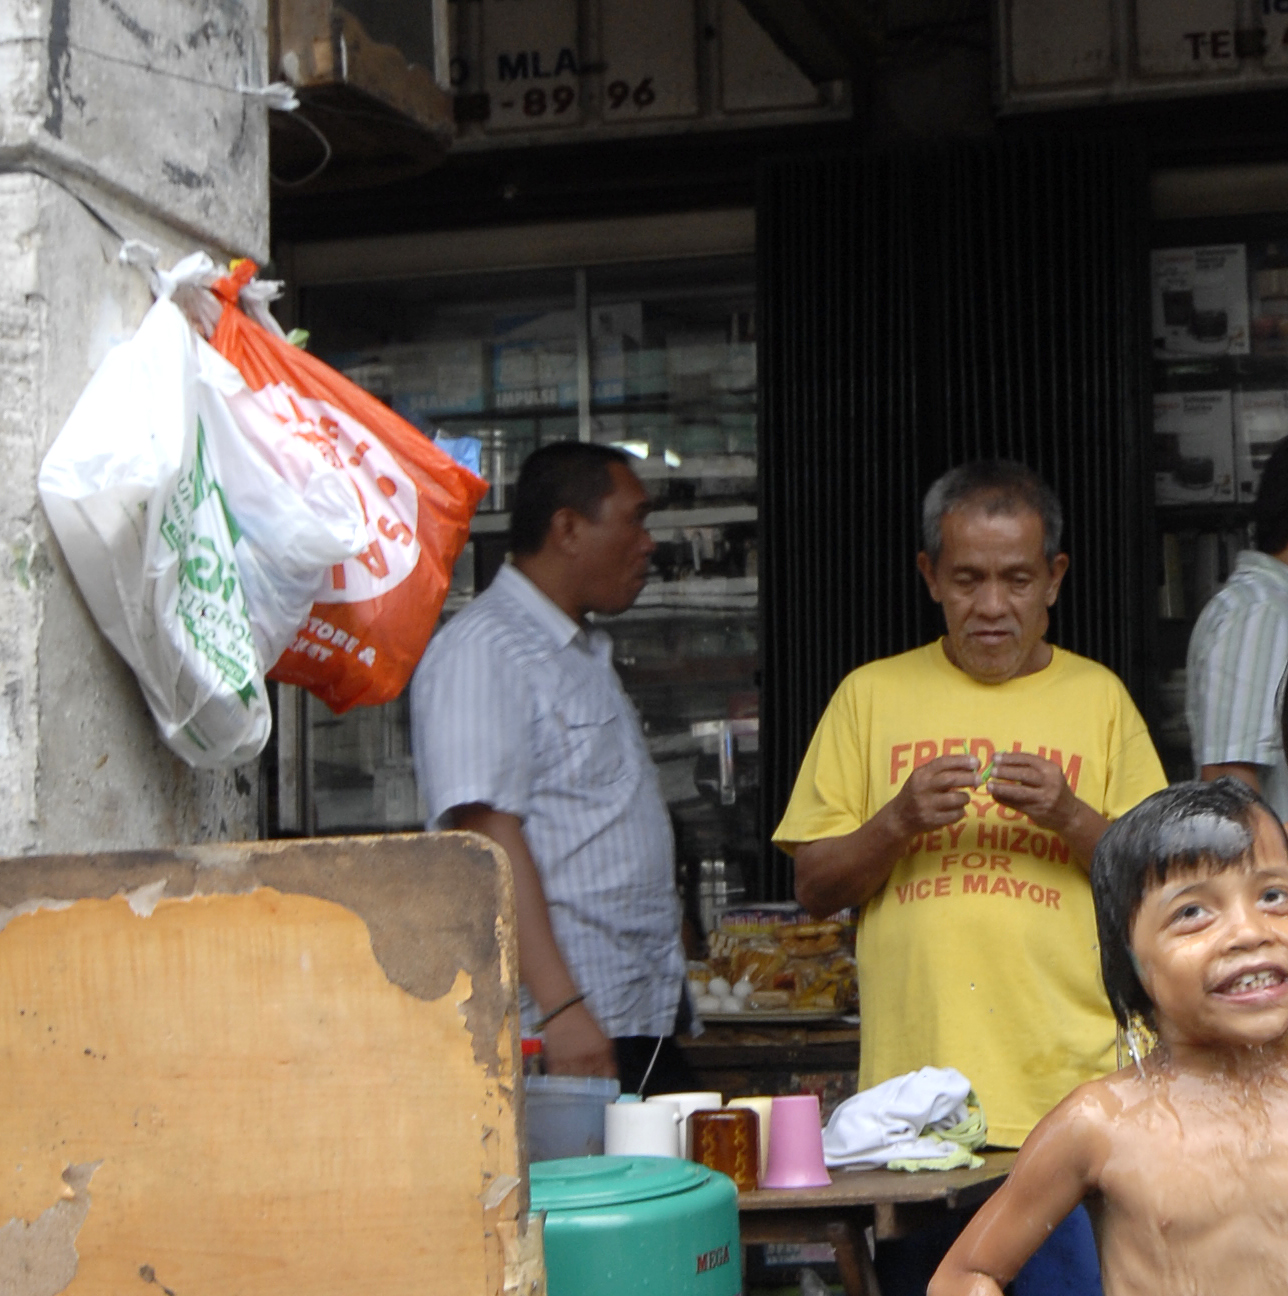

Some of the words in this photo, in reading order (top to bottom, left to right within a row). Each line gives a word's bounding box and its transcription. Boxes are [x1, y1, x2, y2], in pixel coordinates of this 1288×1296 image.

[305, 616, 360, 653] TORE
[977, 823, 1070, 864] HIZON
[941, 852, 1012, 873] FOR
[895, 876, 952, 905] VICE
[962, 874, 1061, 910] MAYOR
[696, 1245, 730, 1275] MEGA
